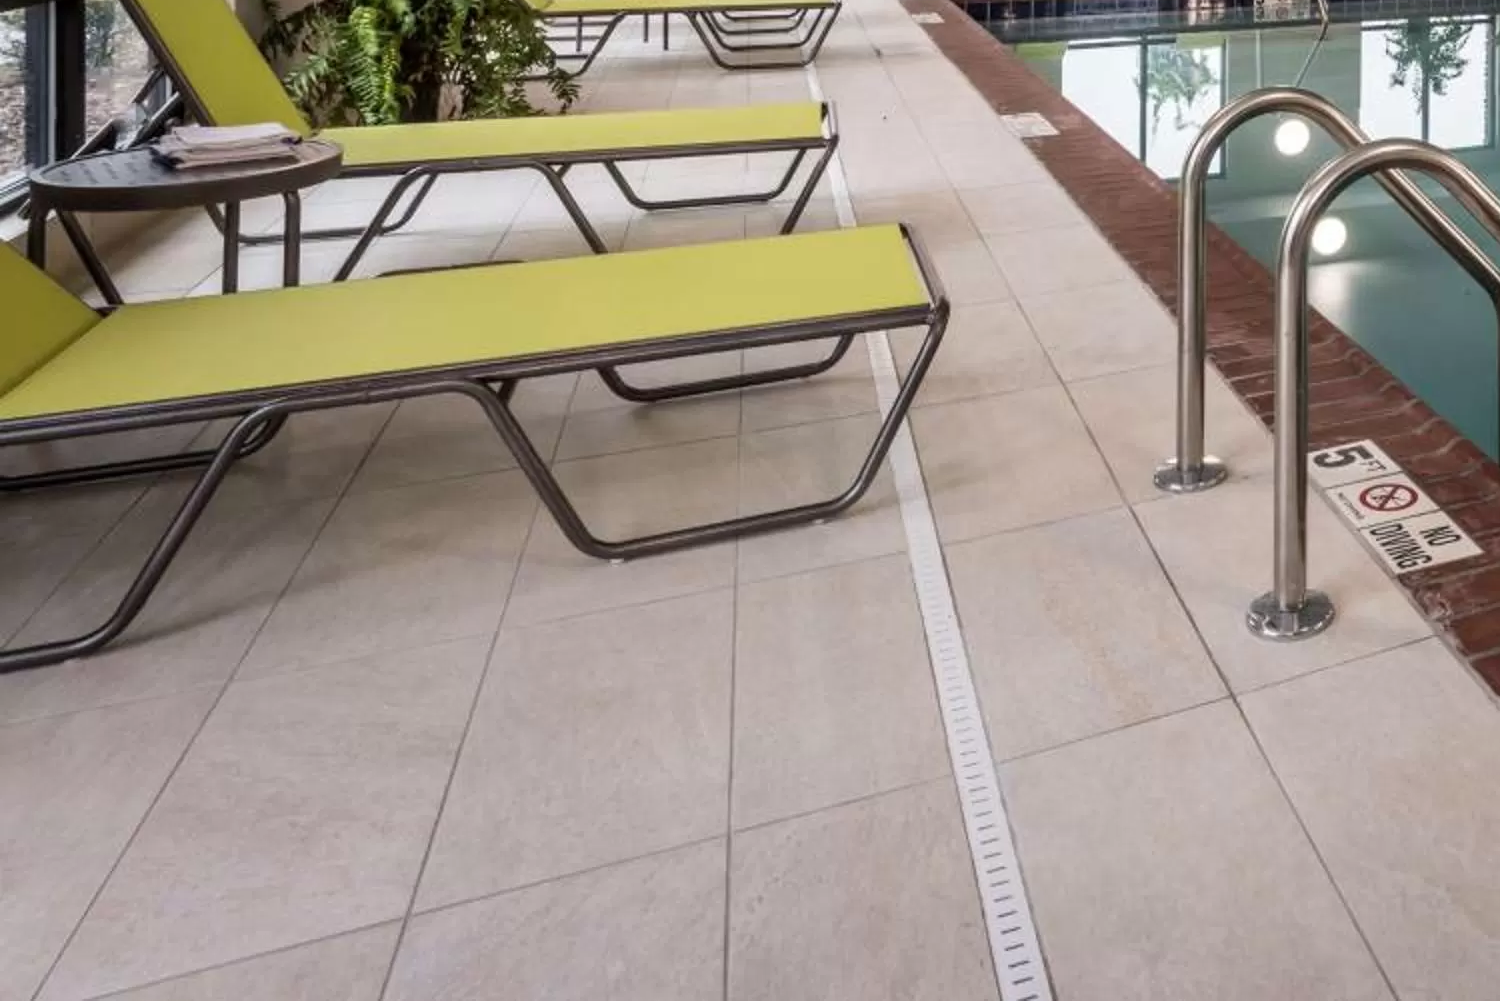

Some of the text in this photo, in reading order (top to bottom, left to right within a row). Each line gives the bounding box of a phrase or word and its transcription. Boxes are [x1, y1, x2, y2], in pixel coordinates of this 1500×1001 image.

[1313, 445, 1388, 473] 5 FT
[1369, 522, 1433, 570] DIVING
[1419, 525, 1462, 548] NO
